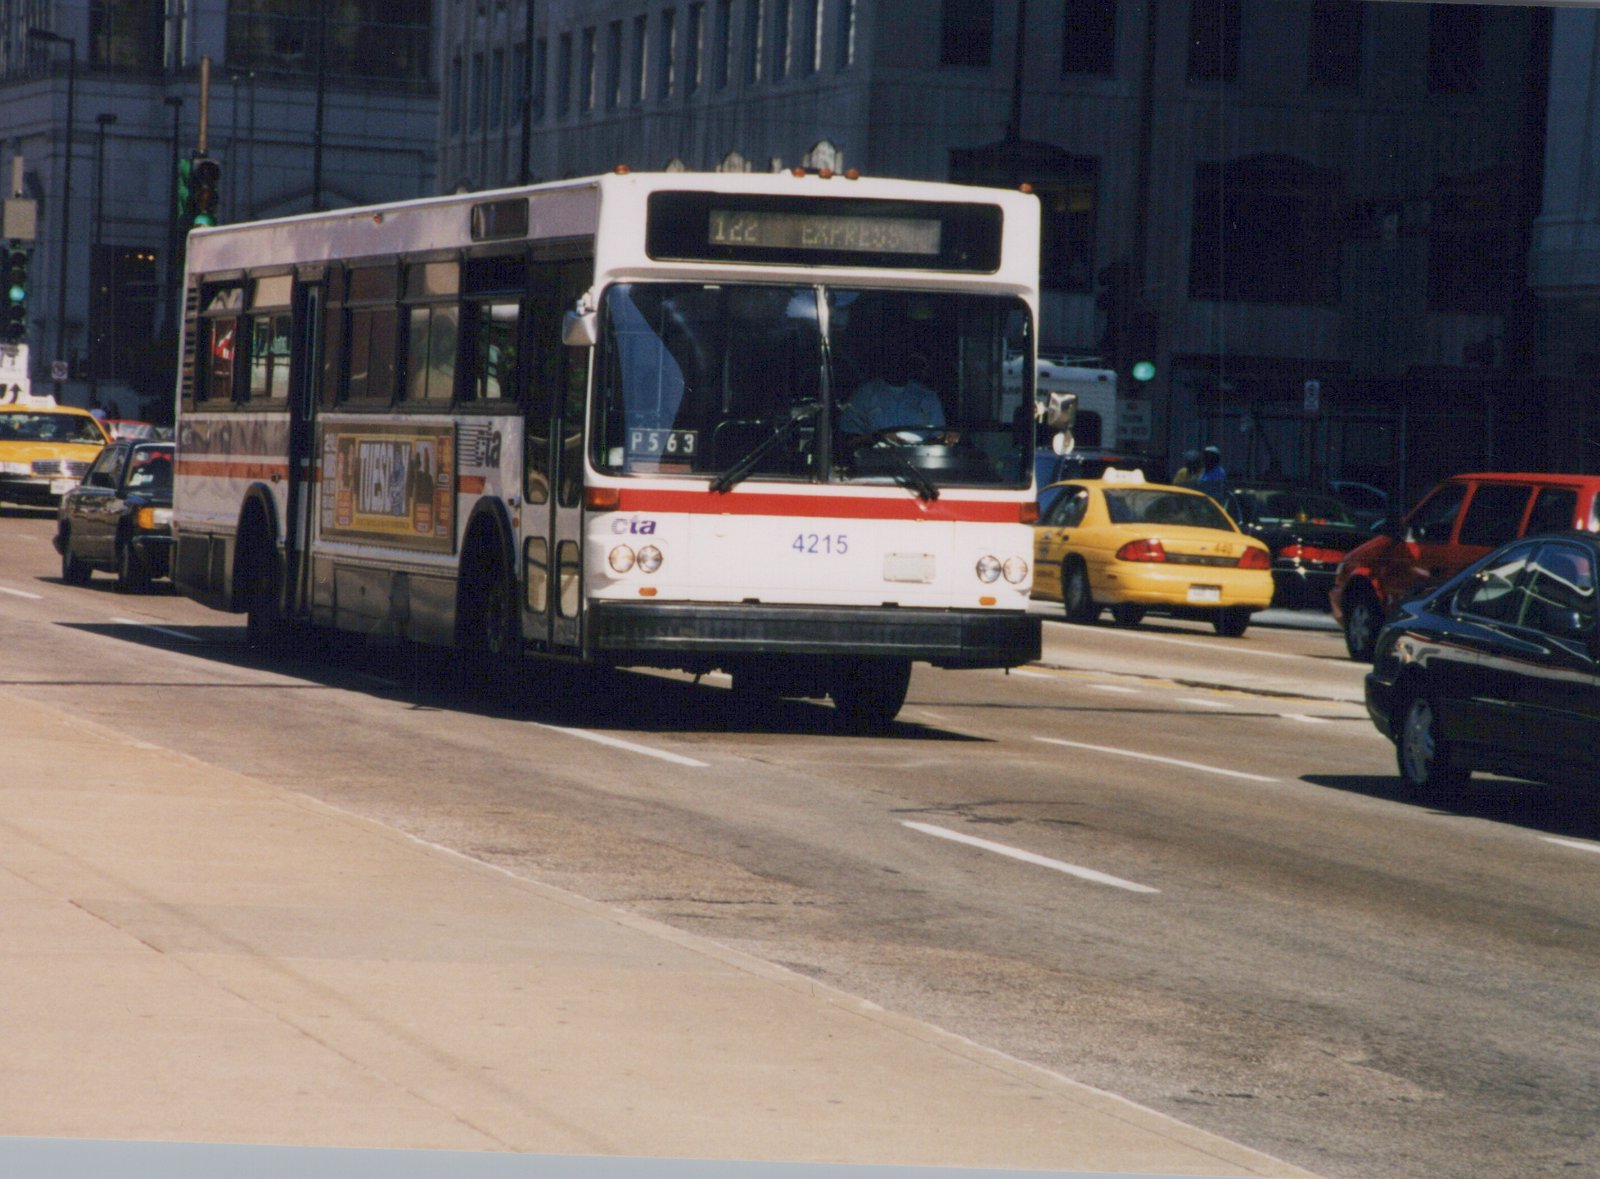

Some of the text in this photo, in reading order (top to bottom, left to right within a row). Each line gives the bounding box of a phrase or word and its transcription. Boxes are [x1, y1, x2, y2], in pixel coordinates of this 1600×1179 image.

[714, 215, 900, 248] 122 EXPRESS
[359, 443, 411, 514] TUESDY
[611, 515, 657, 535] cta
[791, 534, 849, 554] 4215
